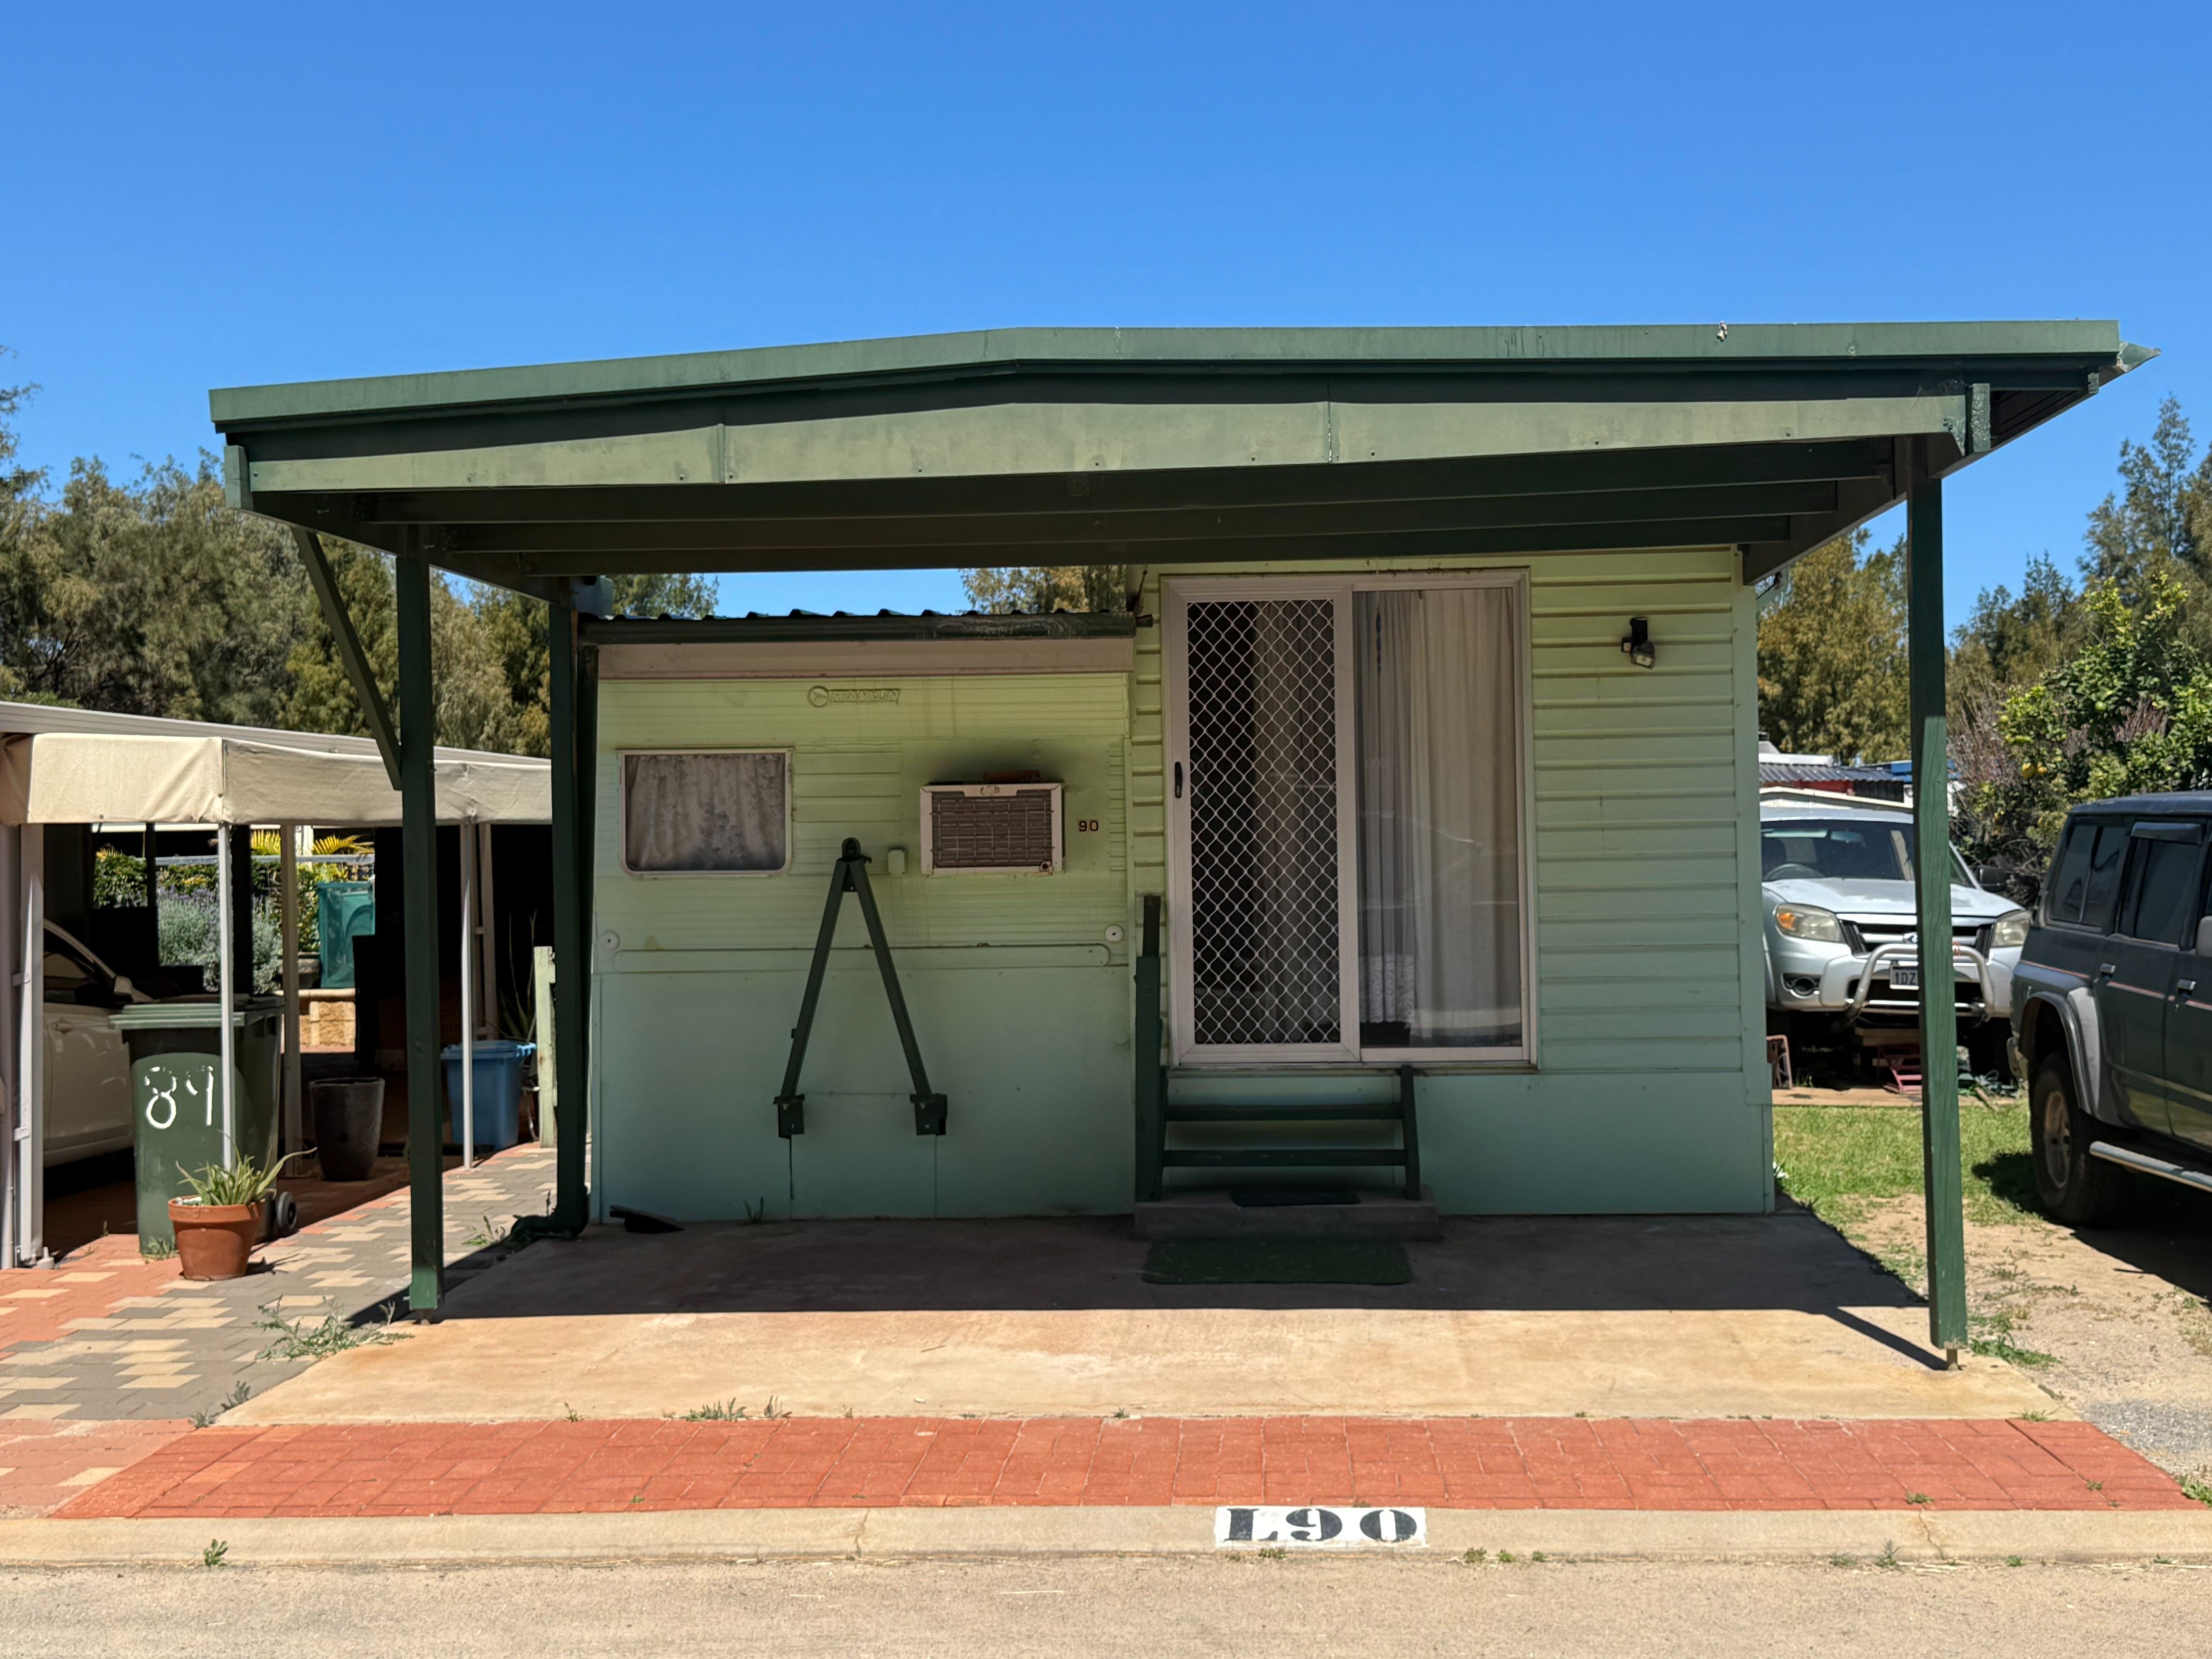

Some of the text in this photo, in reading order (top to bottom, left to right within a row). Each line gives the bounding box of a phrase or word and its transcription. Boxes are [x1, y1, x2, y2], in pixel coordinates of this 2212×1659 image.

[1079, 820, 1098, 832] 90
[1895, 972, 1917, 986] 1DZ
[1224, 1508, 1417, 1543] L90
